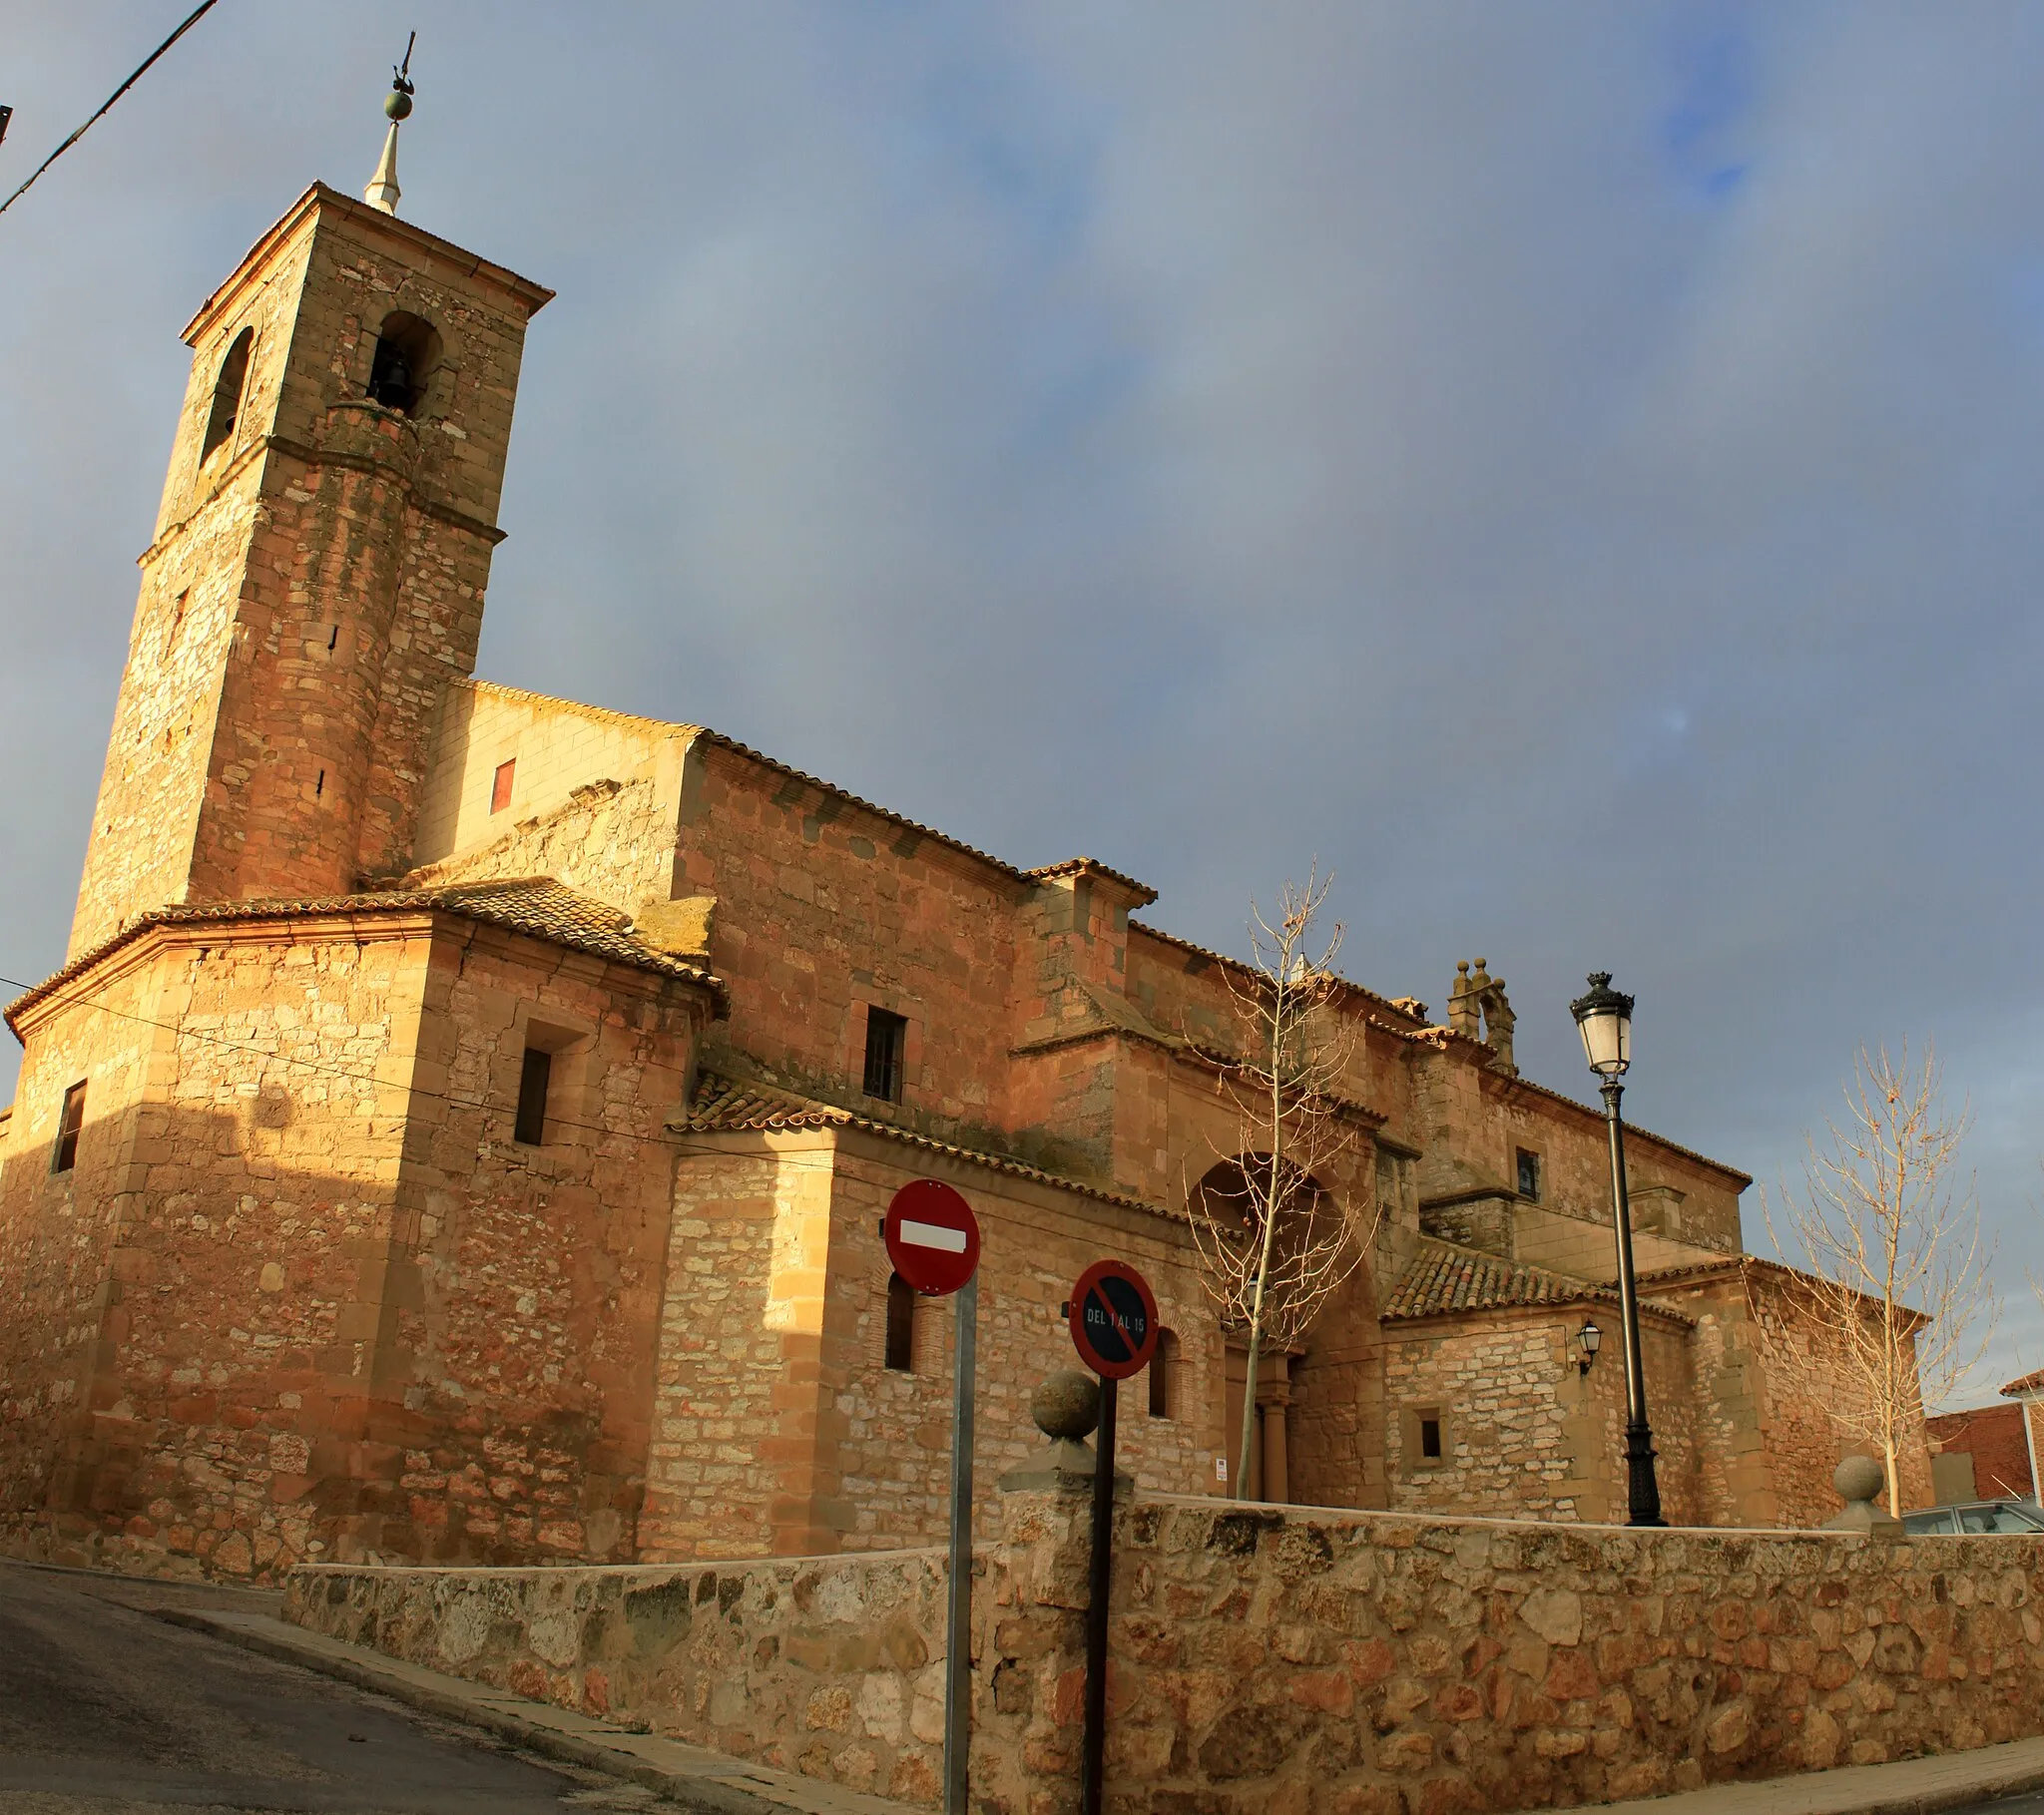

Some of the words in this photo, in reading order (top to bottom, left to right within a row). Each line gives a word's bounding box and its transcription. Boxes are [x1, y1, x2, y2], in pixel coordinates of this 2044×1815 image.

[1087, 1308, 1106, 1325] DEL
[1117, 1314, 1131, 1329] AL
[1134, 1317, 1145, 1332] 15
